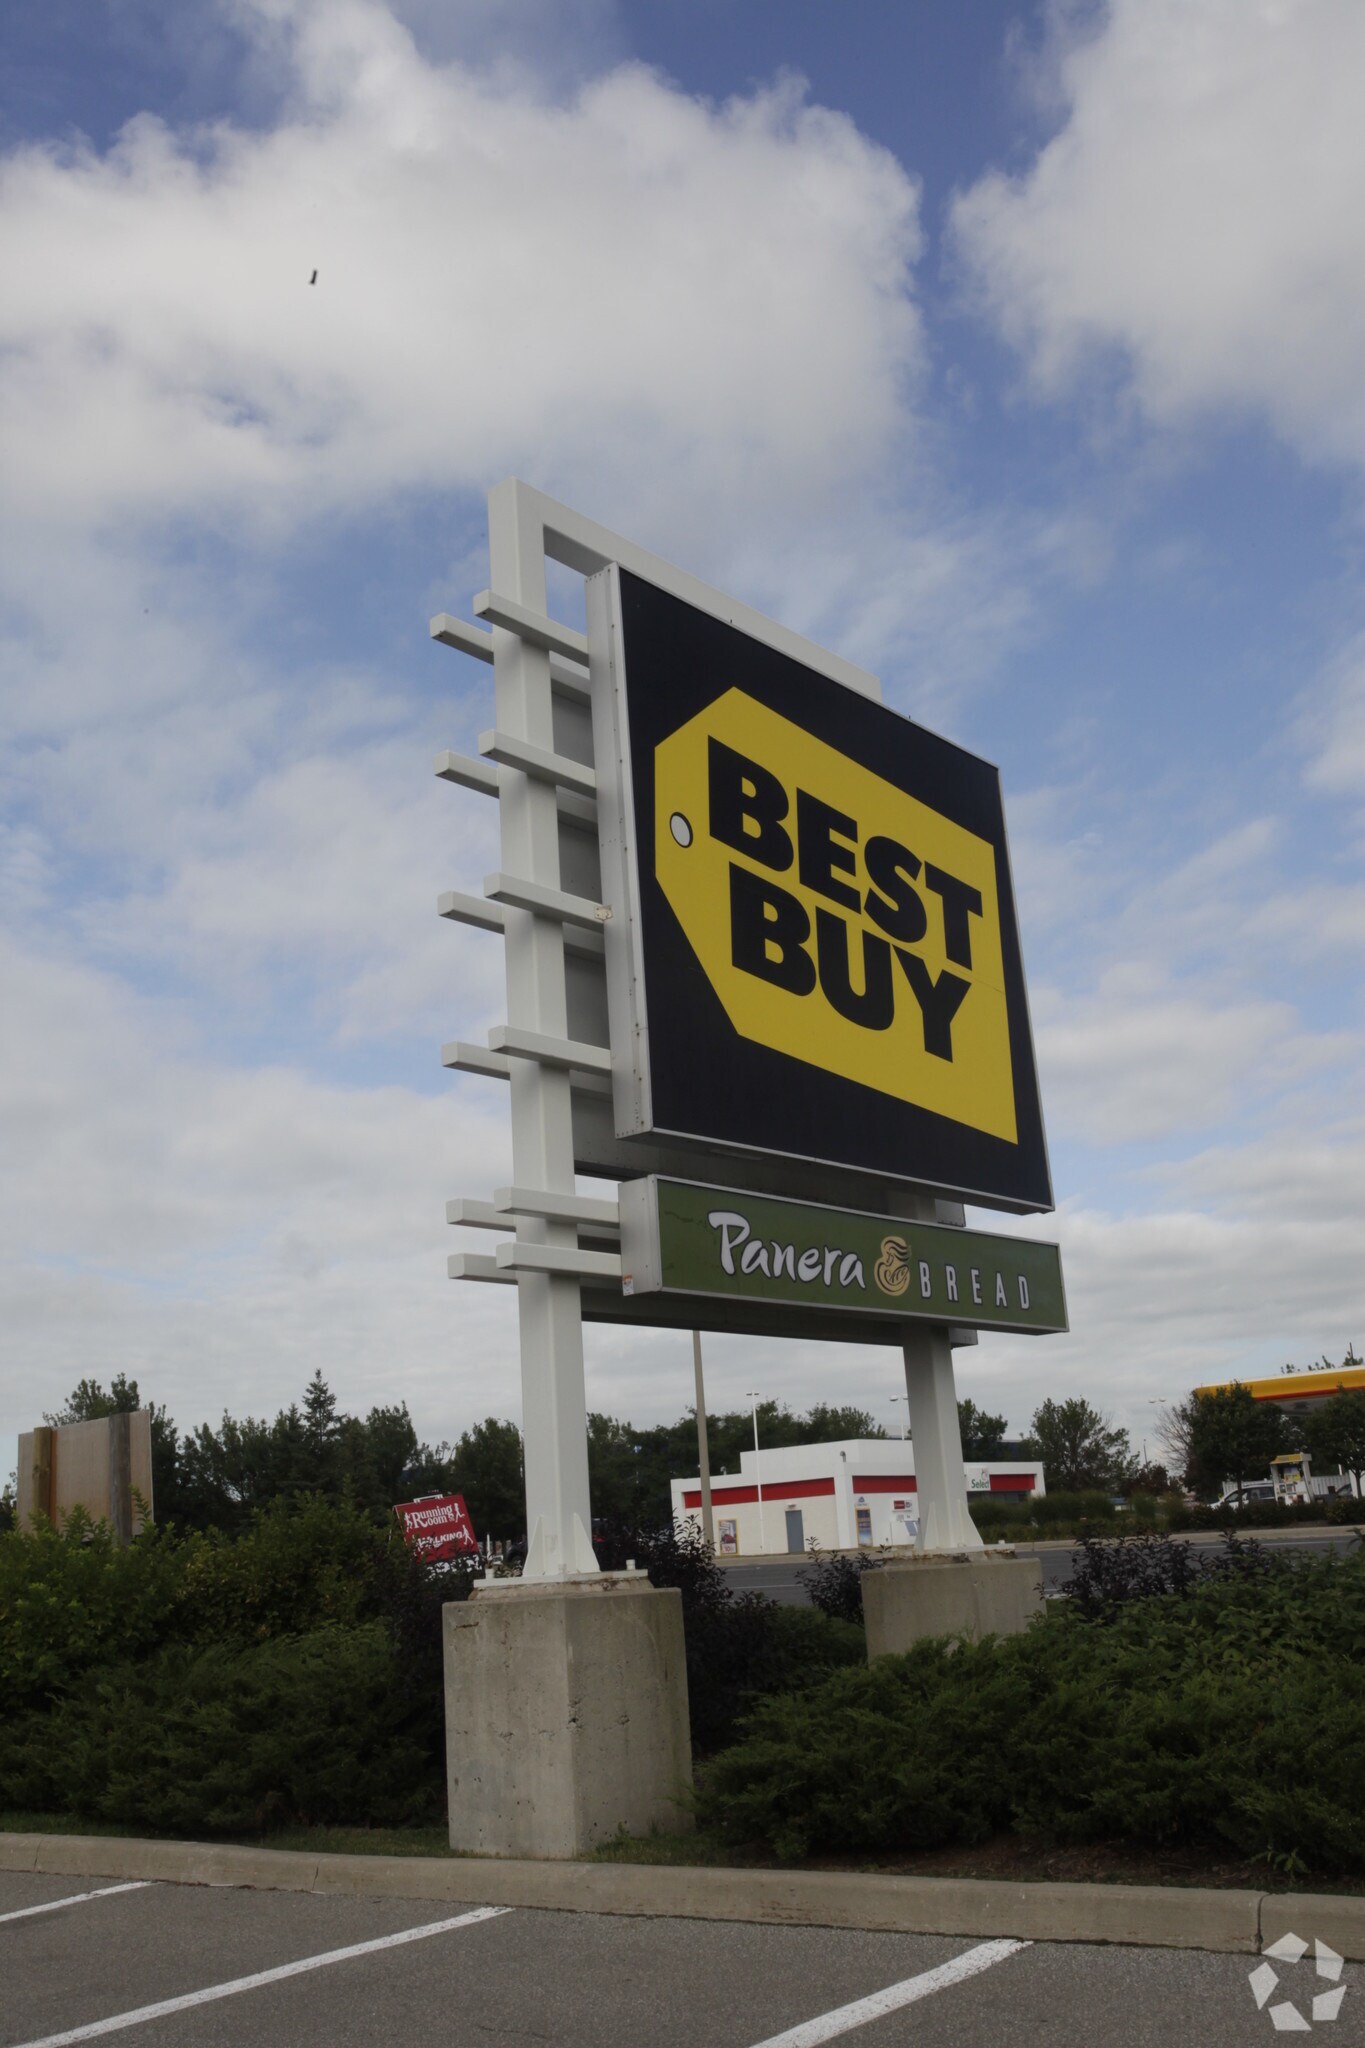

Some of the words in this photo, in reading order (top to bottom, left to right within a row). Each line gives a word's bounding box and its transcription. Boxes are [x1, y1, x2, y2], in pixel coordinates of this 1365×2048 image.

[708, 735, 983, 971] BEST
[729, 861, 972, 1063] BUY
[707, 1211, 866, 1289] Panera
[919, 1261, 1030, 1310] BREAD
[411, 1504, 453, 1528] Running
